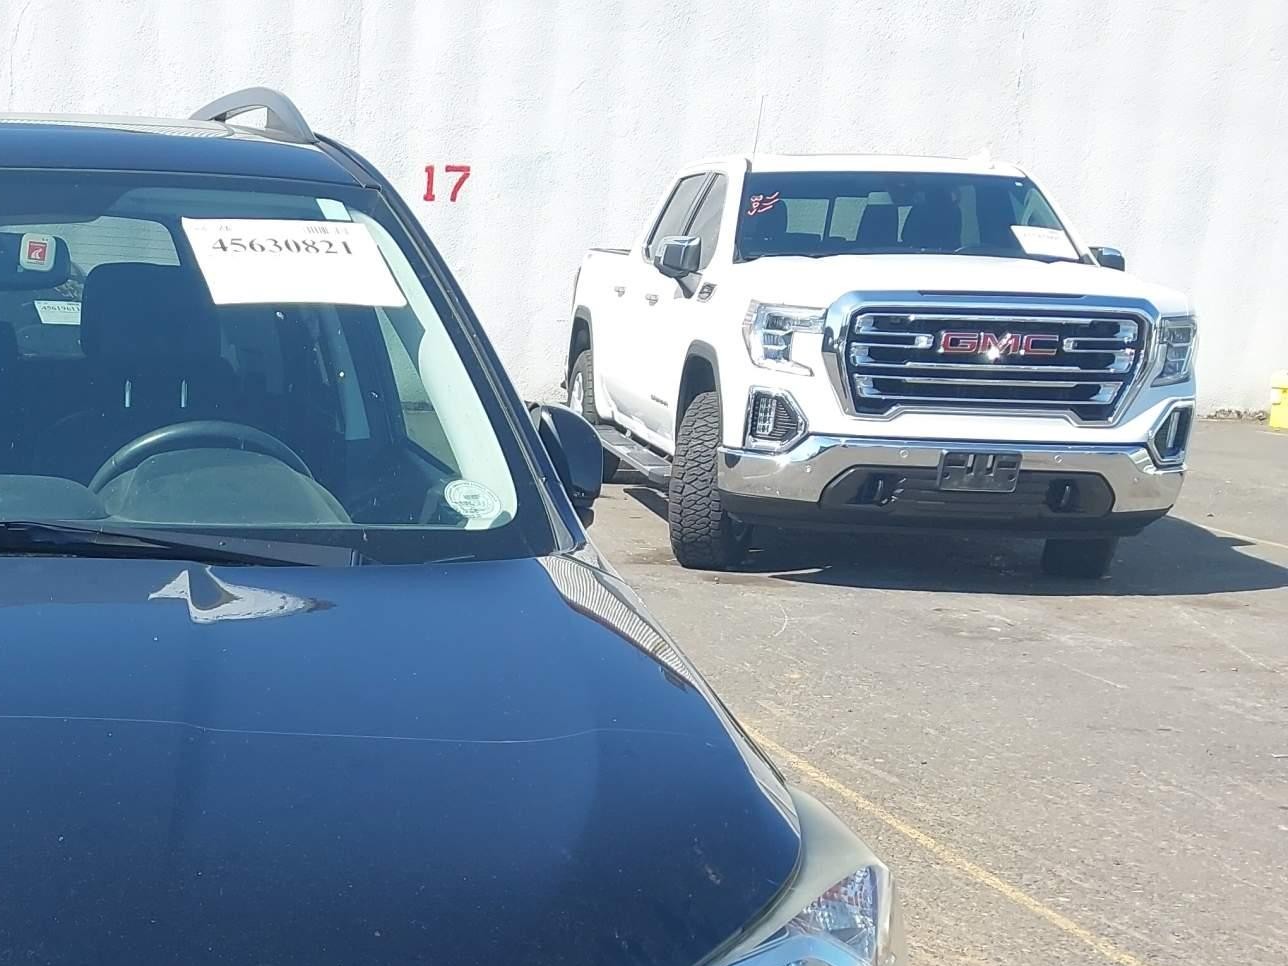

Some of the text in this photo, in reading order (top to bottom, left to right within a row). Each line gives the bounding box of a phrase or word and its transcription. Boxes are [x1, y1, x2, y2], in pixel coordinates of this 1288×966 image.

[423, 165, 471, 202] 17
[211, 237, 353, 255] 45630821
[938, 331, 1059, 356] GMC
